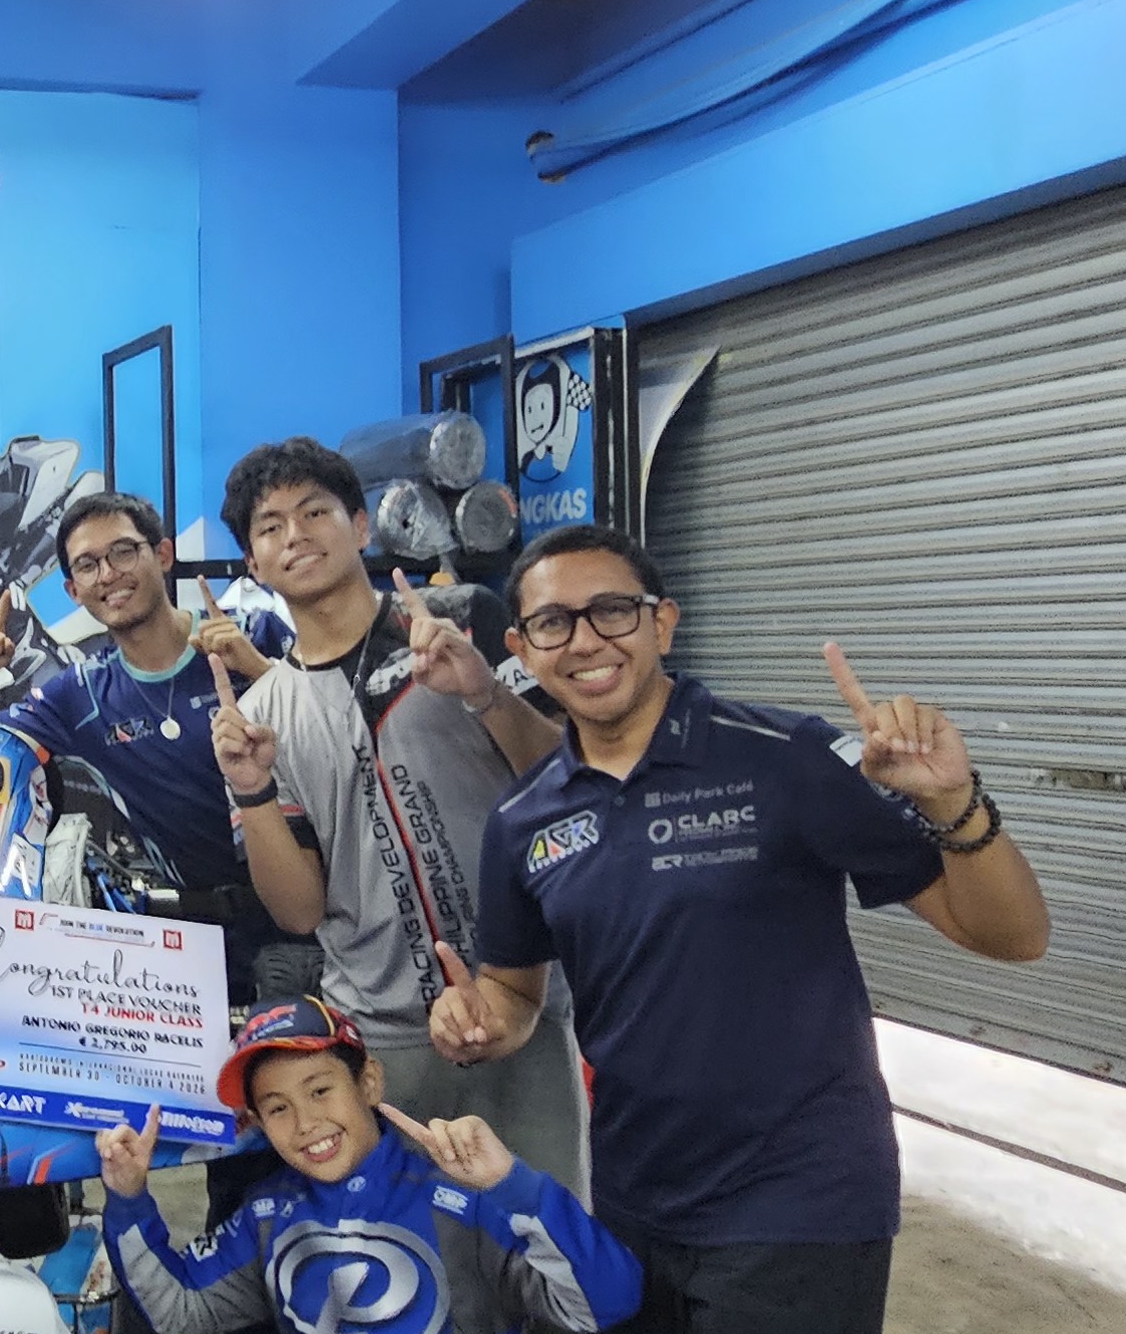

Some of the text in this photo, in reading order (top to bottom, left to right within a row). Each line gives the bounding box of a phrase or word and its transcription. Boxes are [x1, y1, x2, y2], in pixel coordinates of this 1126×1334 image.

[391, 764, 433, 845] GRAND
[677, 805, 756, 828] CLARC
[352, 744, 416, 916] DEVELOPMENT
[404, 917, 439, 1013] RACING
[51, 985, 202, 1016] 1ST PLACE VOUCHER
[104, 1005, 156, 1024] JUNIOR
[159, 1012, 203, 1029] CLASS
[21, 1014, 204, 1049] ANTONIO GREGORIO RACELIS
[19, 1062, 81, 1079] SEPTEMBER
[86, 1070, 100, 1081] 30
[115, 1073, 163, 1089] OCTOBER
